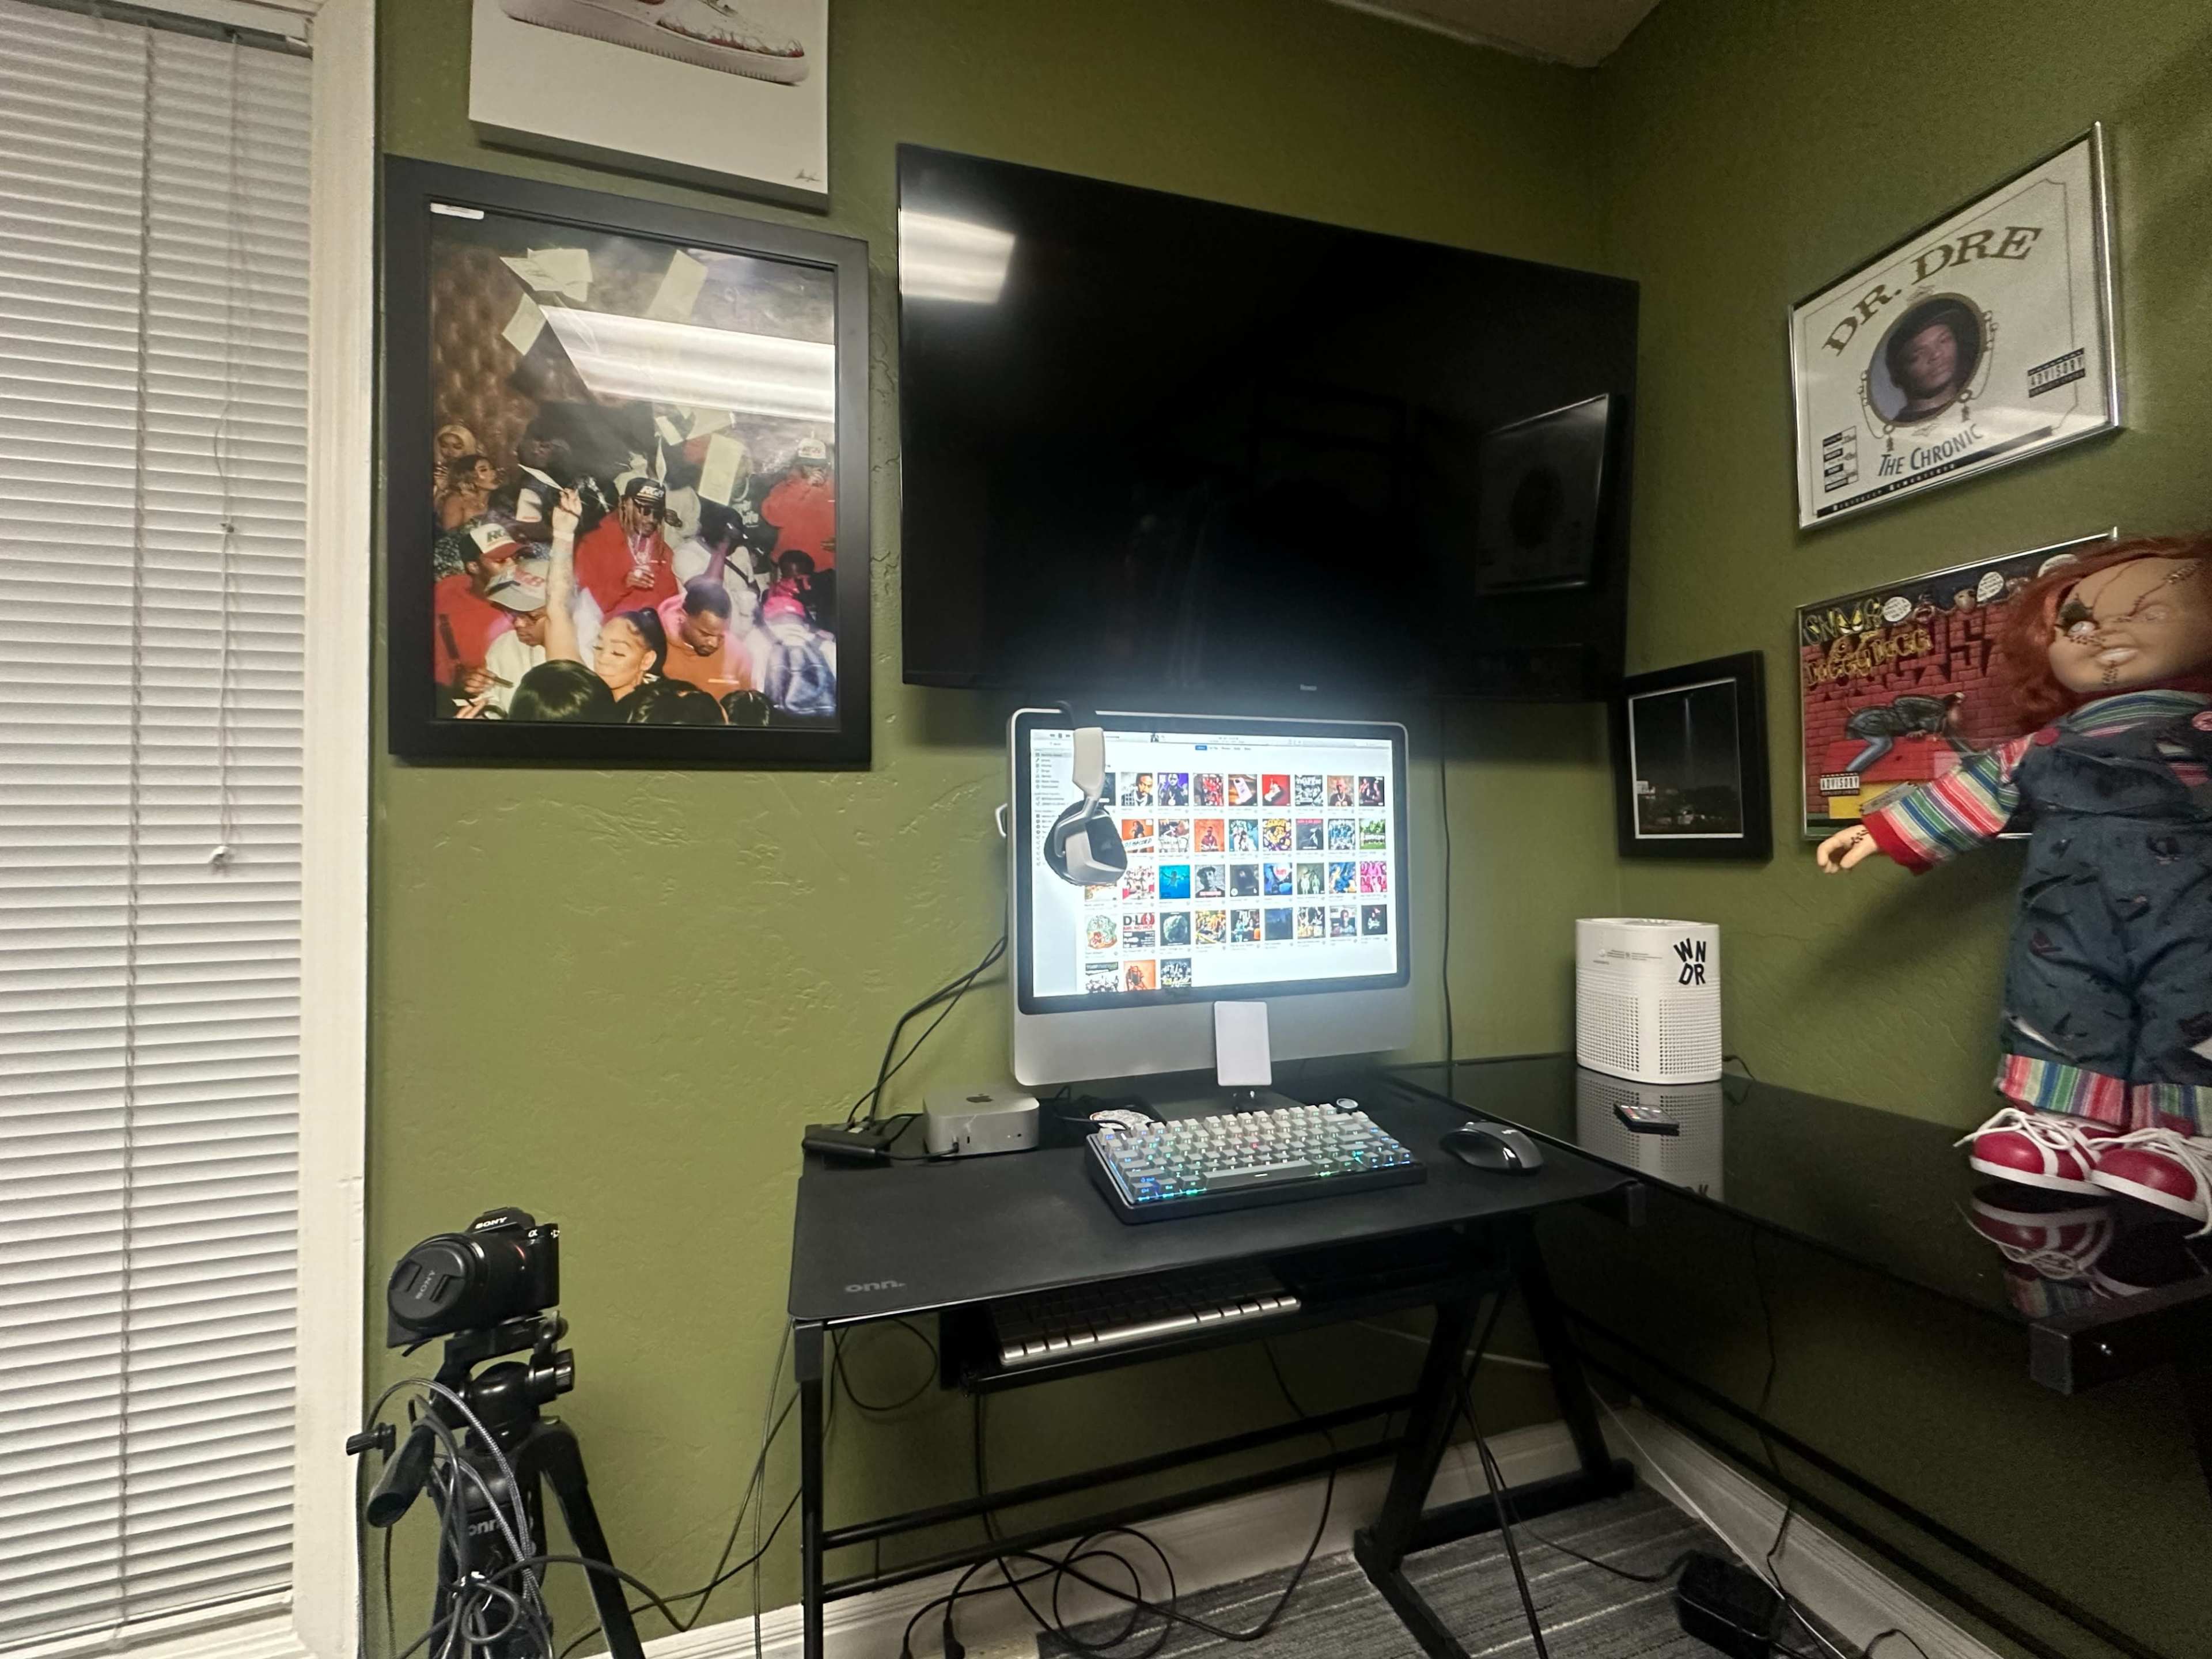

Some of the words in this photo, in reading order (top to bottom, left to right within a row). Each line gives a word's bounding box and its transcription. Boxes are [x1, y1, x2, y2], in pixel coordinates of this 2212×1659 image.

[1821, 283, 1903, 356] DR.
[1910, 226, 2043, 285] DRE
[2031, 357, 2082, 386] ADVISORY
[1821, 777, 1858, 789] ADVISORY
[475, 1217, 507, 1229] SONY
[415, 1270, 435, 1300] SONY
